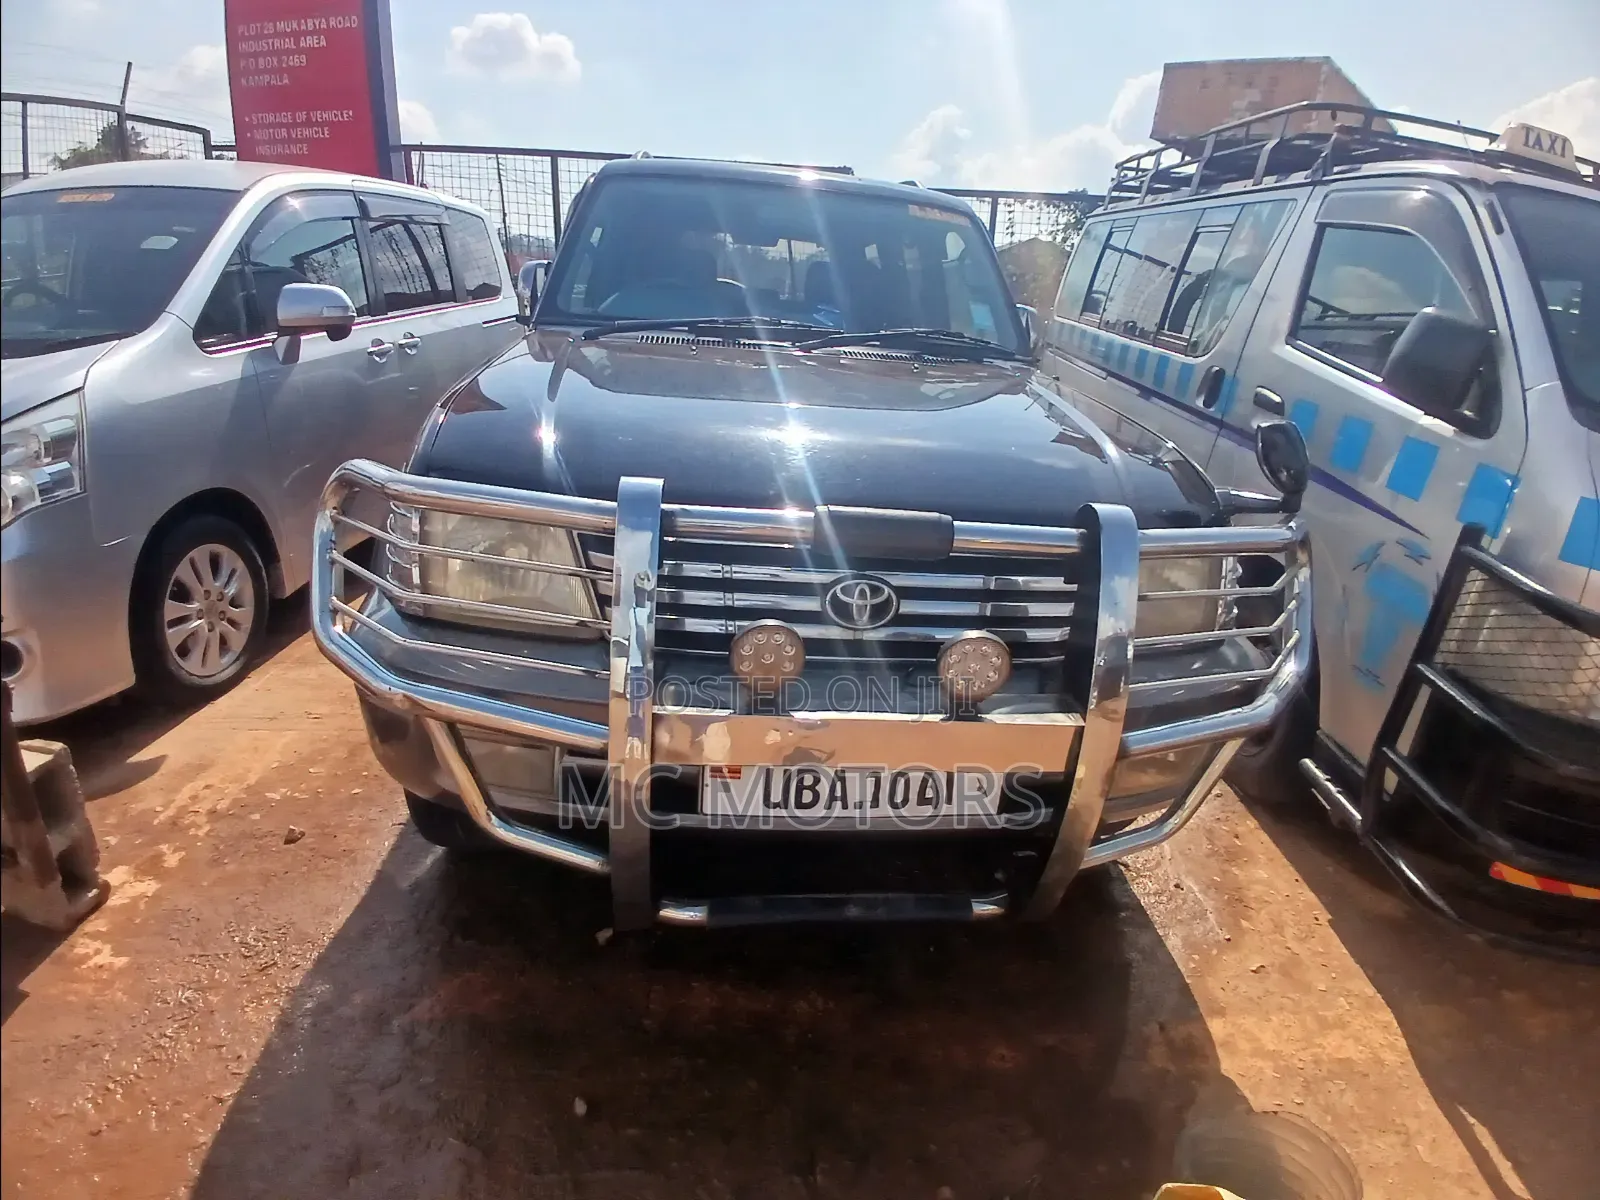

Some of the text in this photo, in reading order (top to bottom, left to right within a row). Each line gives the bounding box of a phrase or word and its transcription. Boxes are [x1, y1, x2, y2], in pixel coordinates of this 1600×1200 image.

[238, 23, 261, 36] PLOT
[329, 15, 358, 29] ROAD
[239, 35, 327, 53] INDUSTRIAL AREA
[258, 56, 278, 69] BOX
[281, 54, 307, 68] 2469
[241, 73, 290, 87] KAMPALA
[251, 112, 293, 125] STORAGE
[295, 111, 308, 123] OF
[254, 126, 330, 140] MOTOR VEHICLE
[1521, 126, 1567, 158] TAXI
[255, 143, 309, 156] INSURANCE
